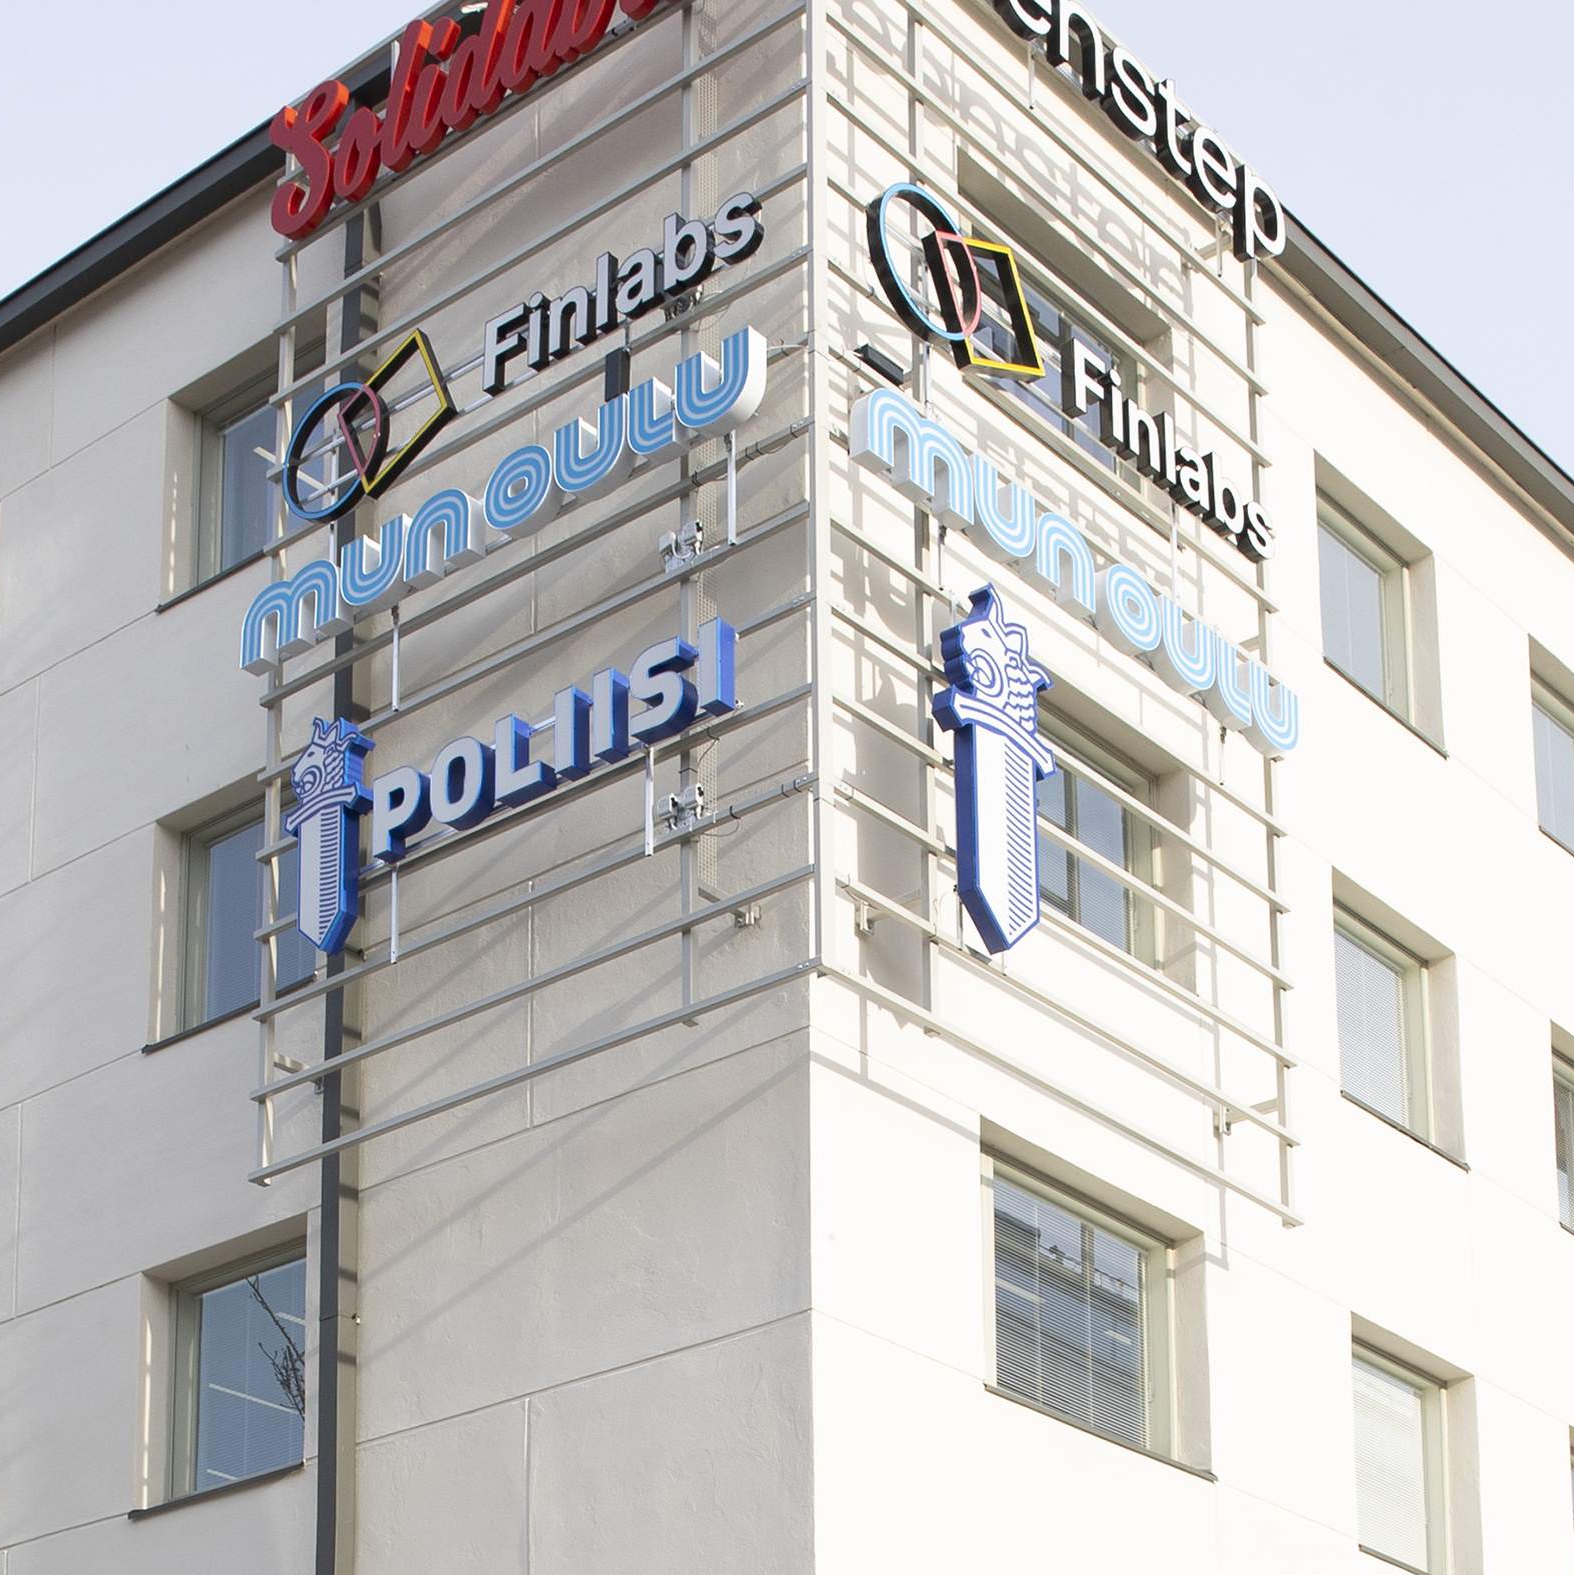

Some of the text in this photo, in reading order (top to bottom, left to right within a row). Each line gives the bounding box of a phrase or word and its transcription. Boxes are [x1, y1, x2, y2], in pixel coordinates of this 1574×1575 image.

[483, 190, 767, 397] Finlabs
[1059, 337, 1275, 564] Finlabs
[372, 616, 742, 862] POLIISI
